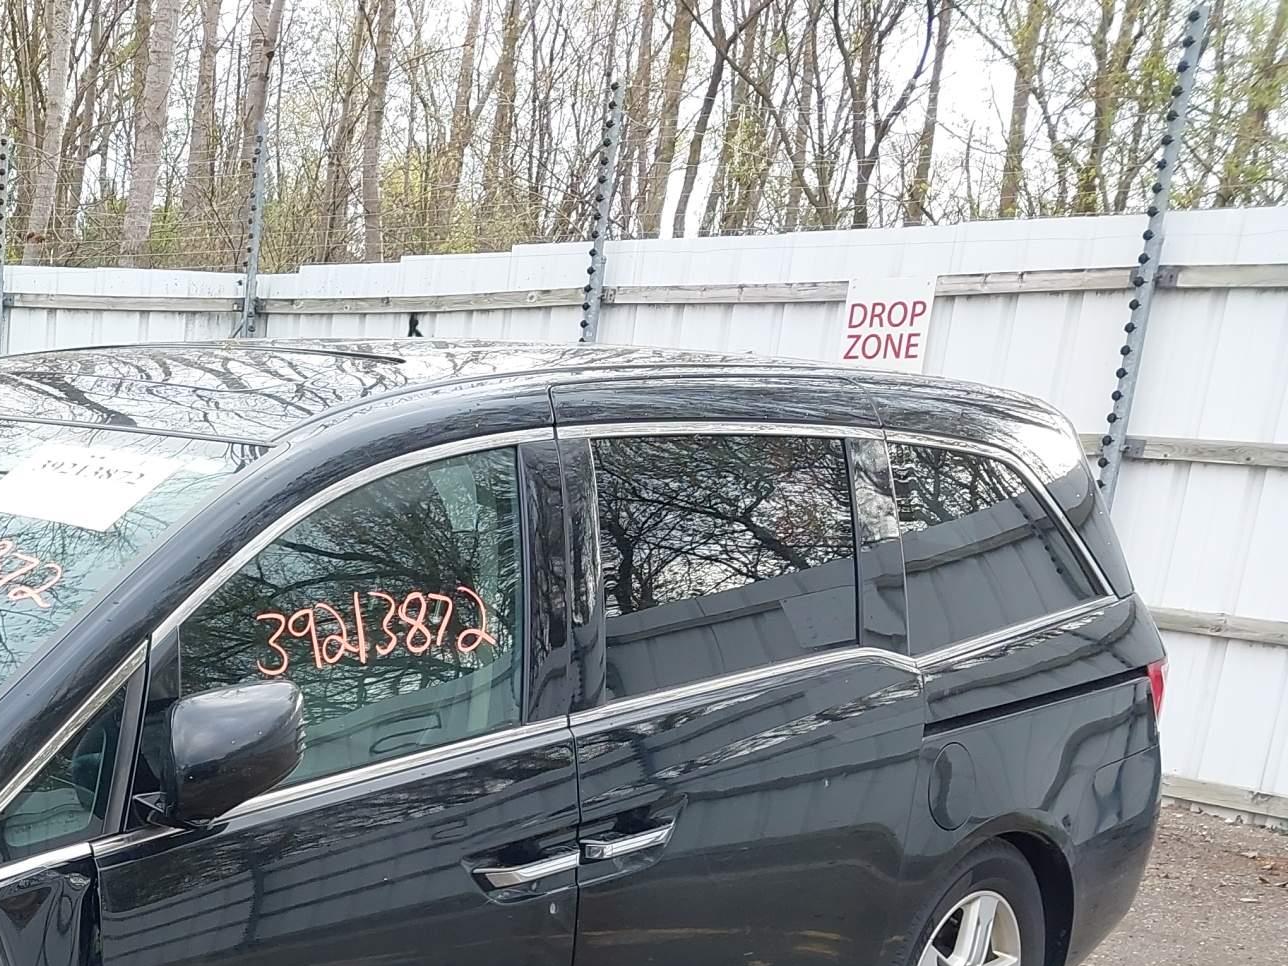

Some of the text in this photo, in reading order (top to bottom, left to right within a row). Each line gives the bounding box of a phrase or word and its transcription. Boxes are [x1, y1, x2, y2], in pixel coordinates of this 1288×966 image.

[848, 300, 927, 328] DROP
[843, 332, 921, 359] ZONE
[256, 586, 497, 676] 39213872
